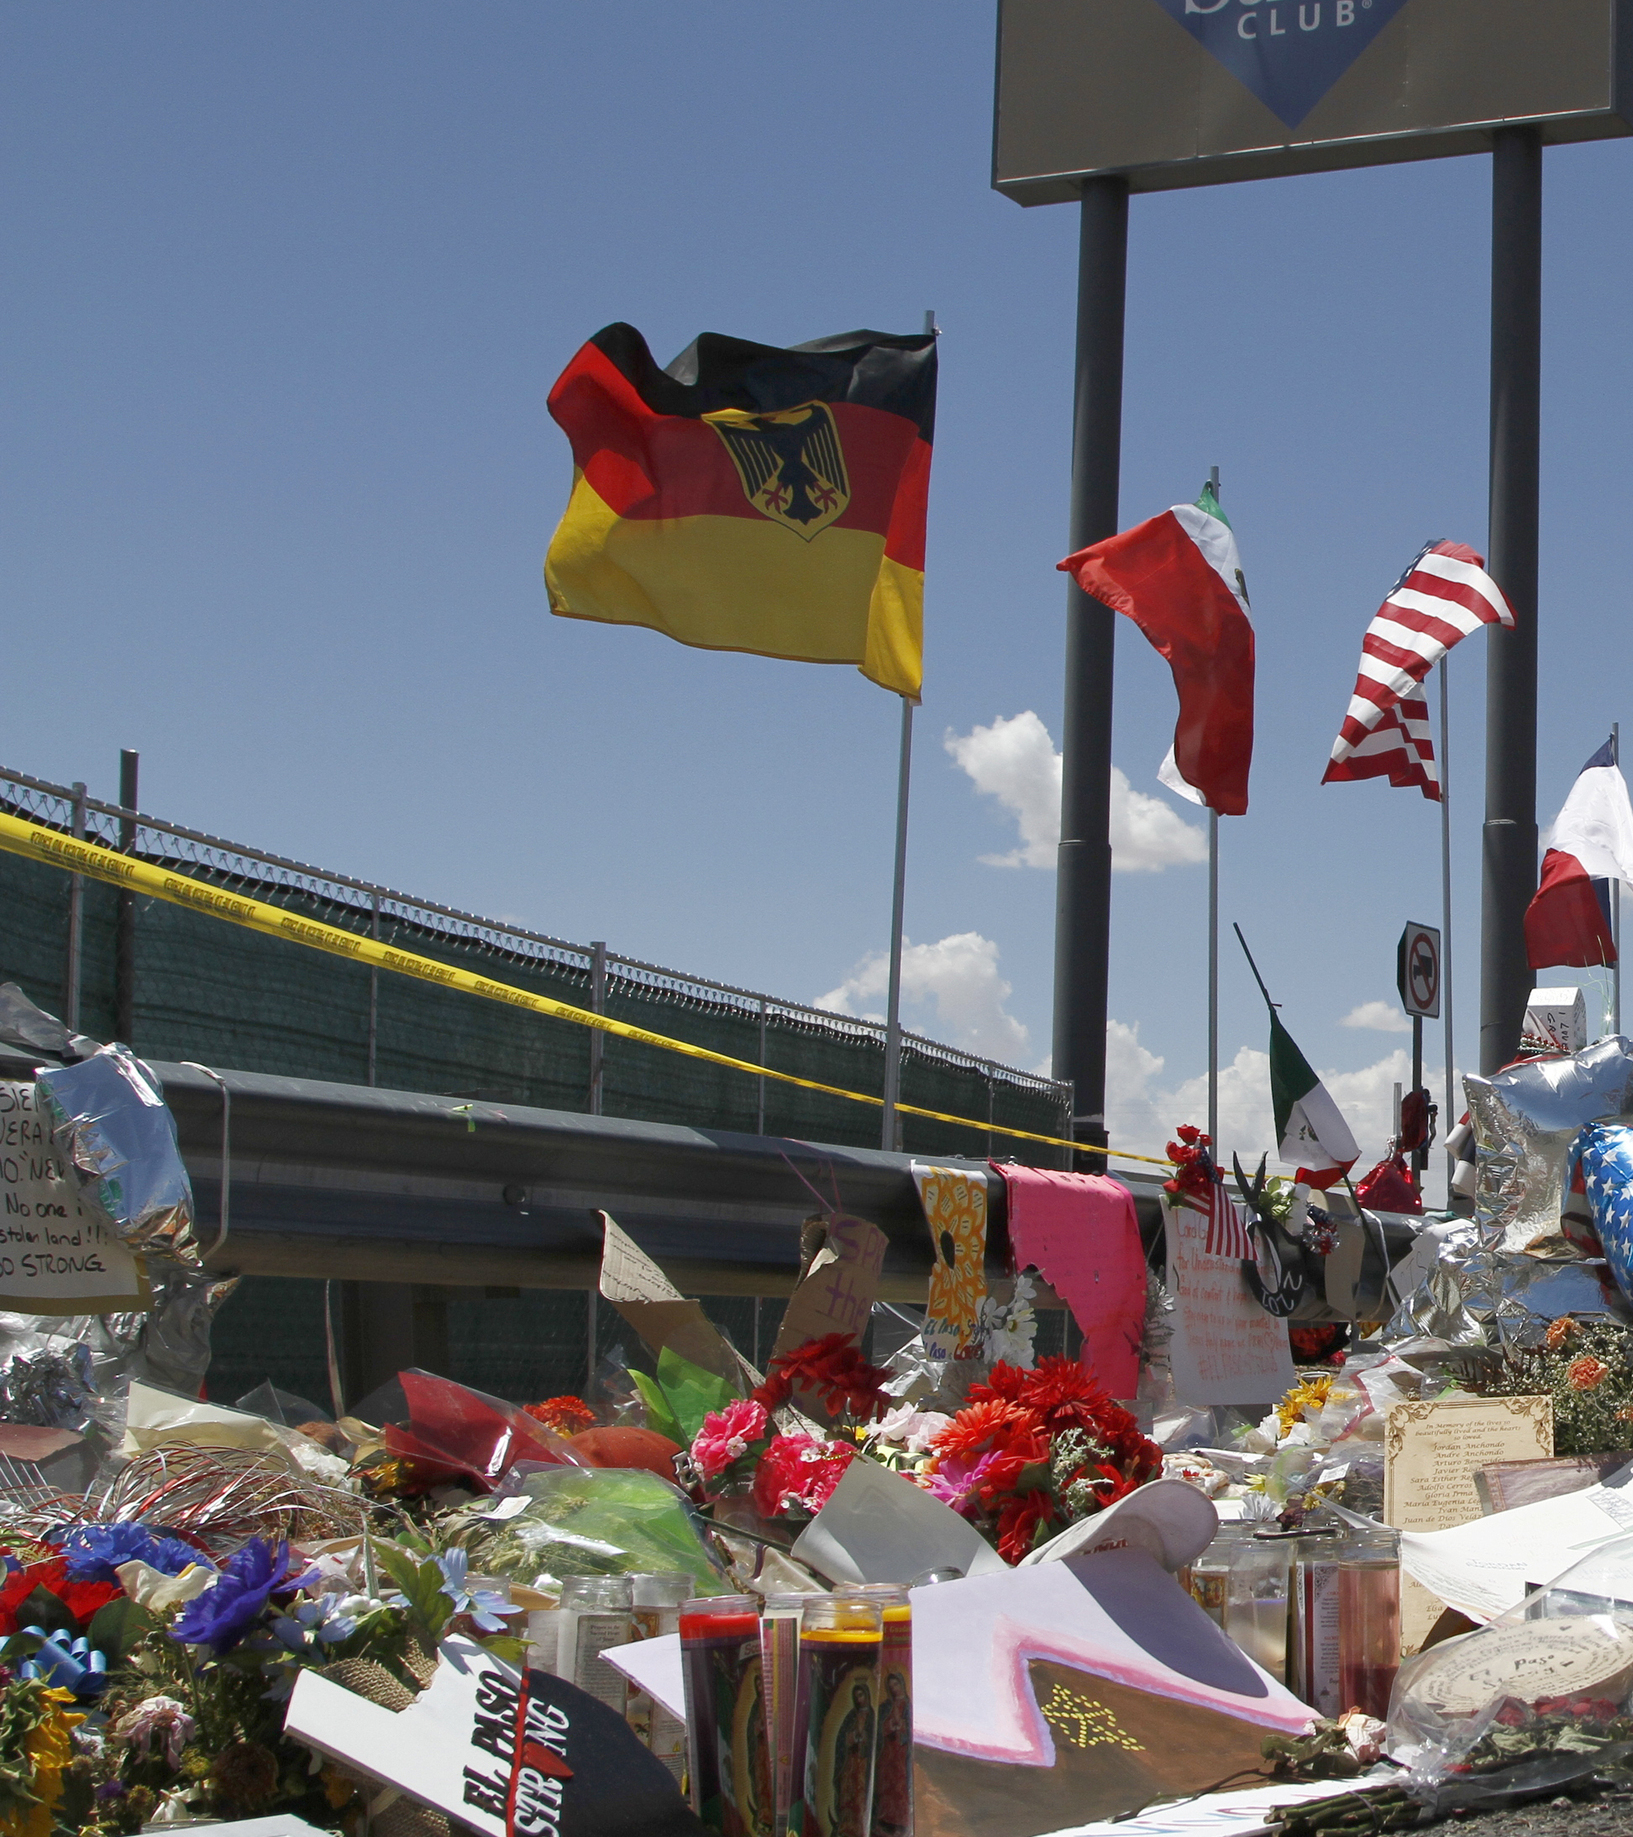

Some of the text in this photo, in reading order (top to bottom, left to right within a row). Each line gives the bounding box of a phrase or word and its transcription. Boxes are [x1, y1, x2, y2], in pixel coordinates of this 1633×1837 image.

[1237, 0, 1355, 40] CLUB
[1547, 1013, 1556, 1033] GR
[6, 1193, 30, 1217] No
[37, 1204, 67, 1218] one
[22, 1253, 106, 1277] STRONG
[825, 1272, 869, 1333] the
[1415, 1428, 1452, 1436] beautifully
[1432, 1441, 1505, 1452] Jordan Anchondo
[1434, 1449, 1504, 1459] Andre Anchondo
[1433, 1459, 1462, 1467] Arturo
[1417, 1483, 1445, 1494] Adolfo
[1425, 1492, 1450, 1500] Gloria
[1432, 1499, 1465, 1507] Eugenia
[462, 1670, 521, 1821] EL PASO
